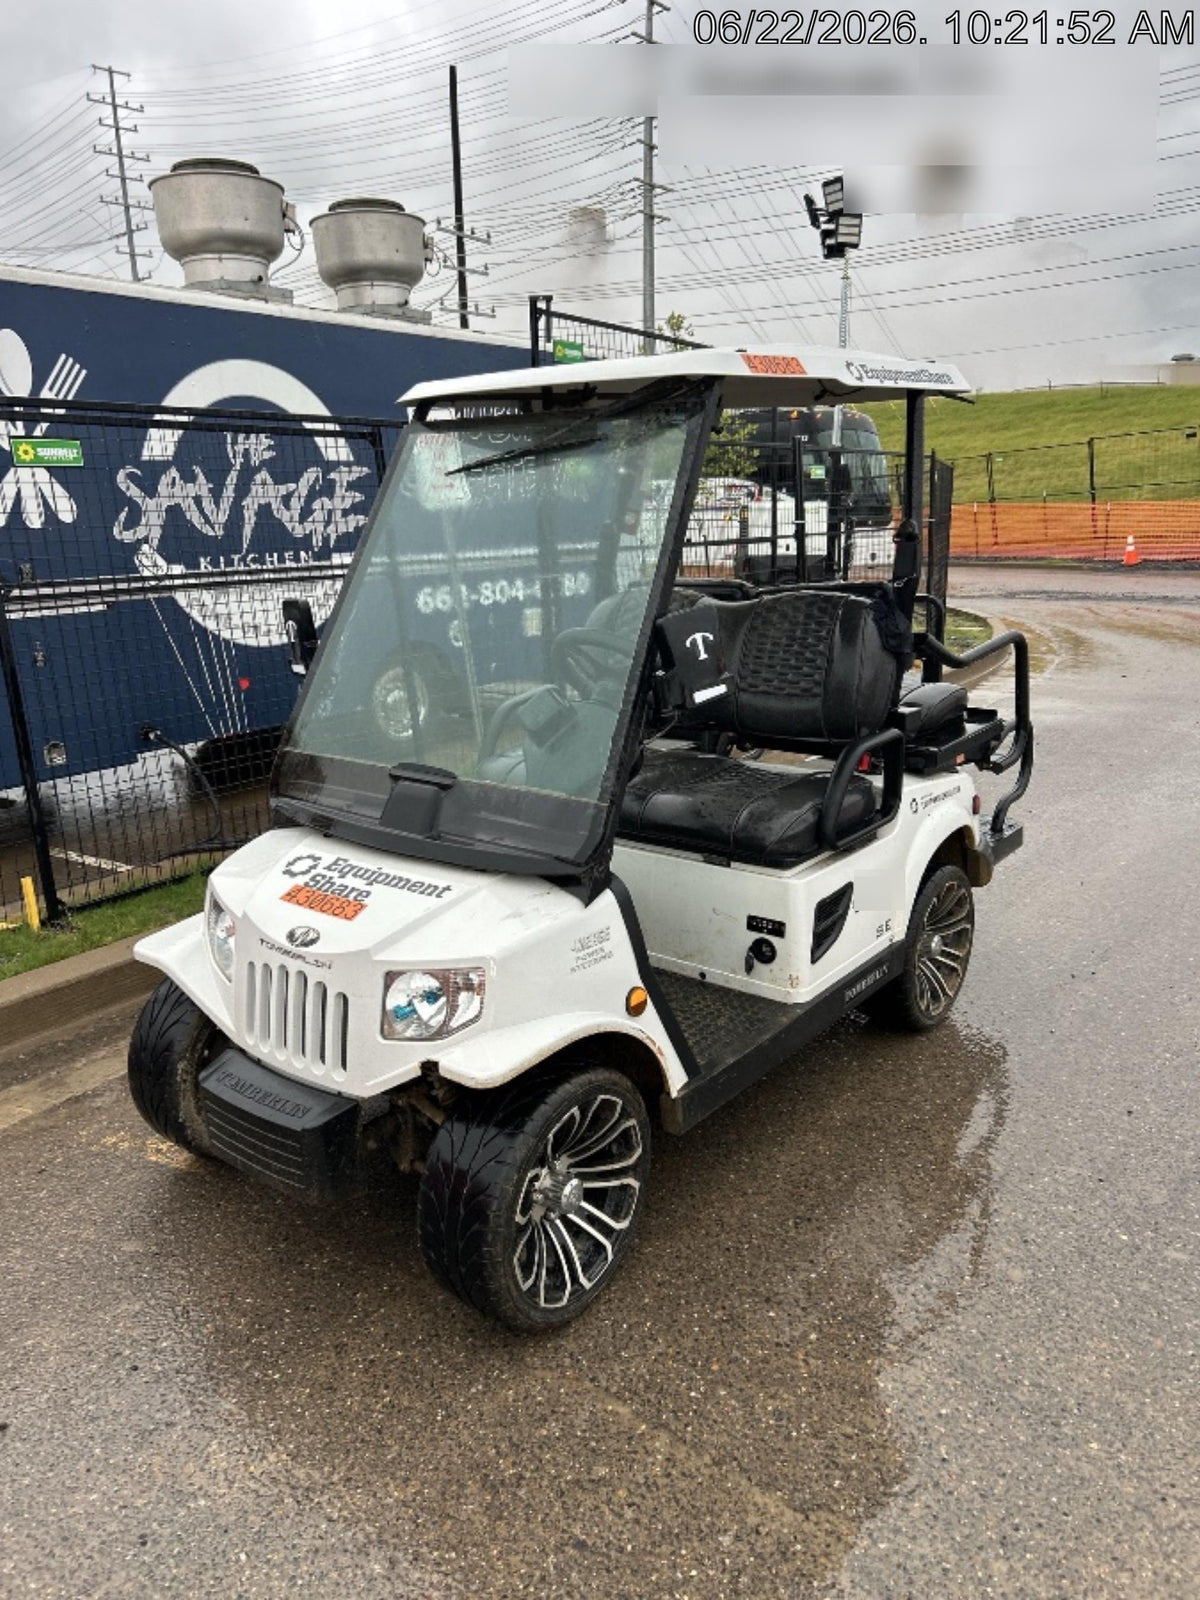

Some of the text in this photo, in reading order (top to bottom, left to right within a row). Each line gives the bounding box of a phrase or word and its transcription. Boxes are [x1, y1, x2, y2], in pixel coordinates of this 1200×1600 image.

[223, 431, 276, 467] THE
[113, 465, 372, 555] SAVAGE
[199, 550, 313, 571] KITCHEN
[685, 632, 714, 660] T
[303, 873, 372, 902] Share
[323, 856, 452, 899] Equipment
